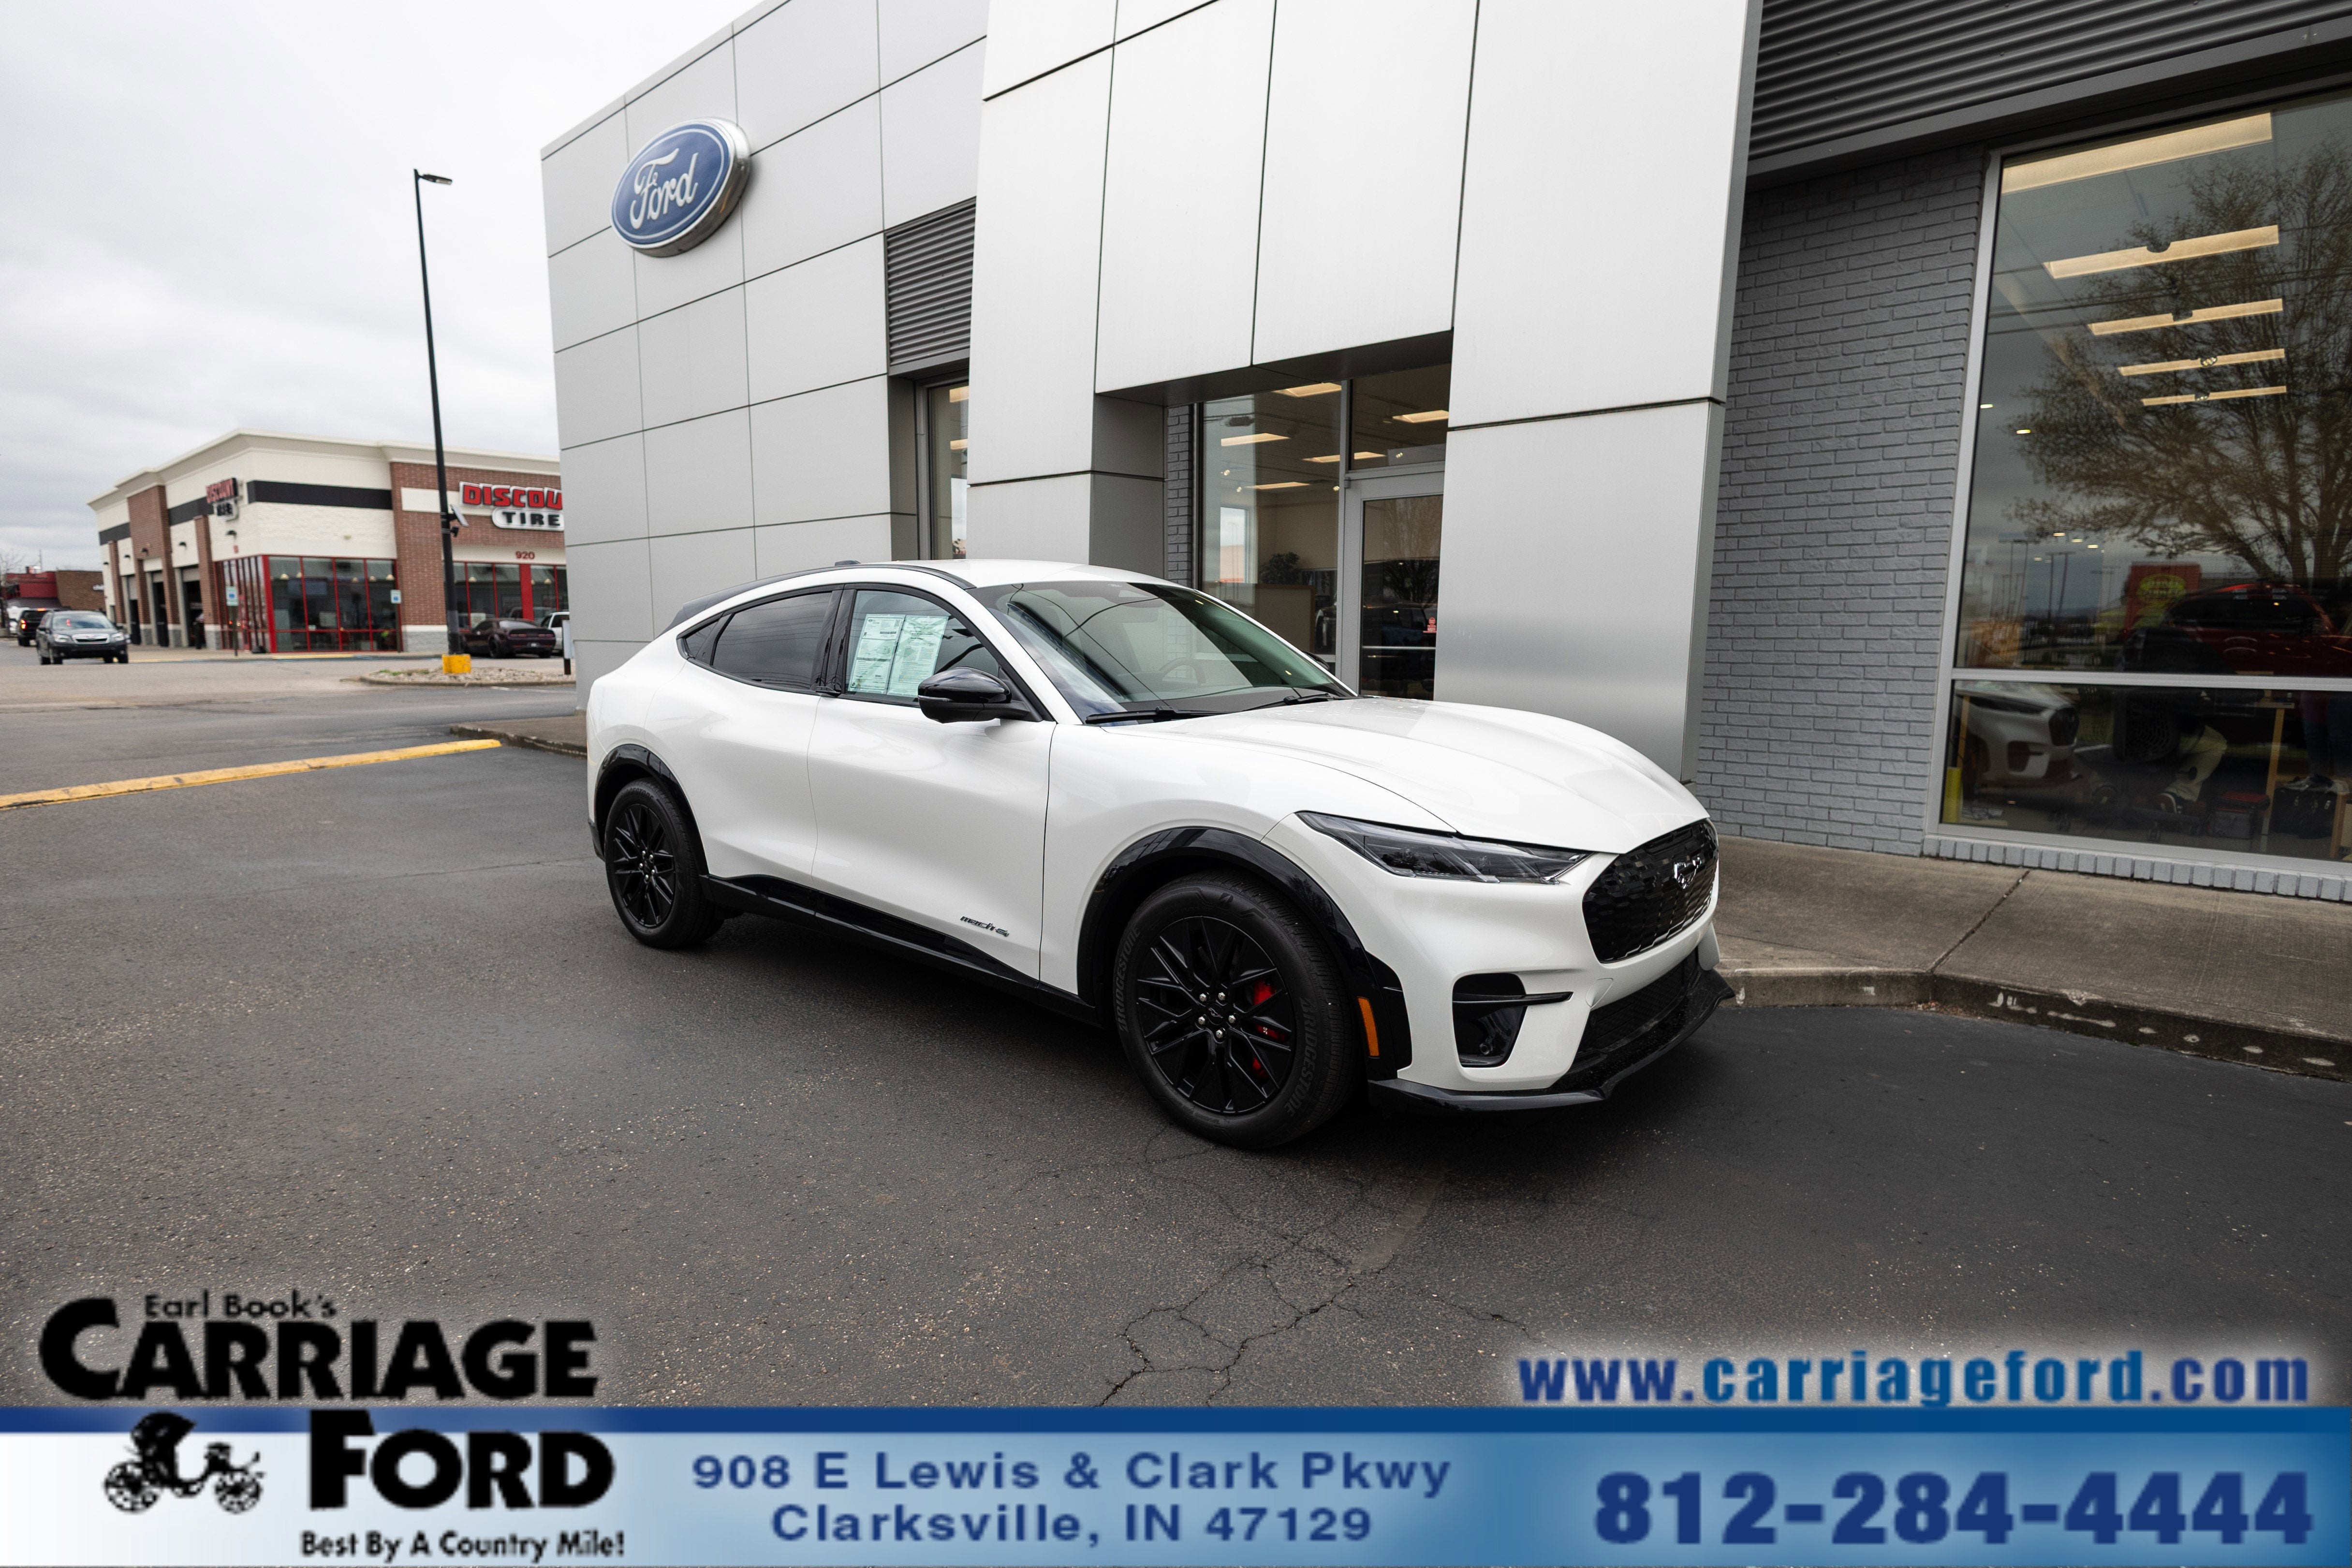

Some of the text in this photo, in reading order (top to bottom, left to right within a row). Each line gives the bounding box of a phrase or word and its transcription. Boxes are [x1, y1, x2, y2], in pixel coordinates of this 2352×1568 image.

[630, 148, 699, 230] Ford
[502, 512, 561, 527] TIRE
[515, 551, 535, 559] 920
[1116, 926, 1140, 1034] BRIDGESTONE
[1283, 996, 1318, 1118] BRIDGESTONE
